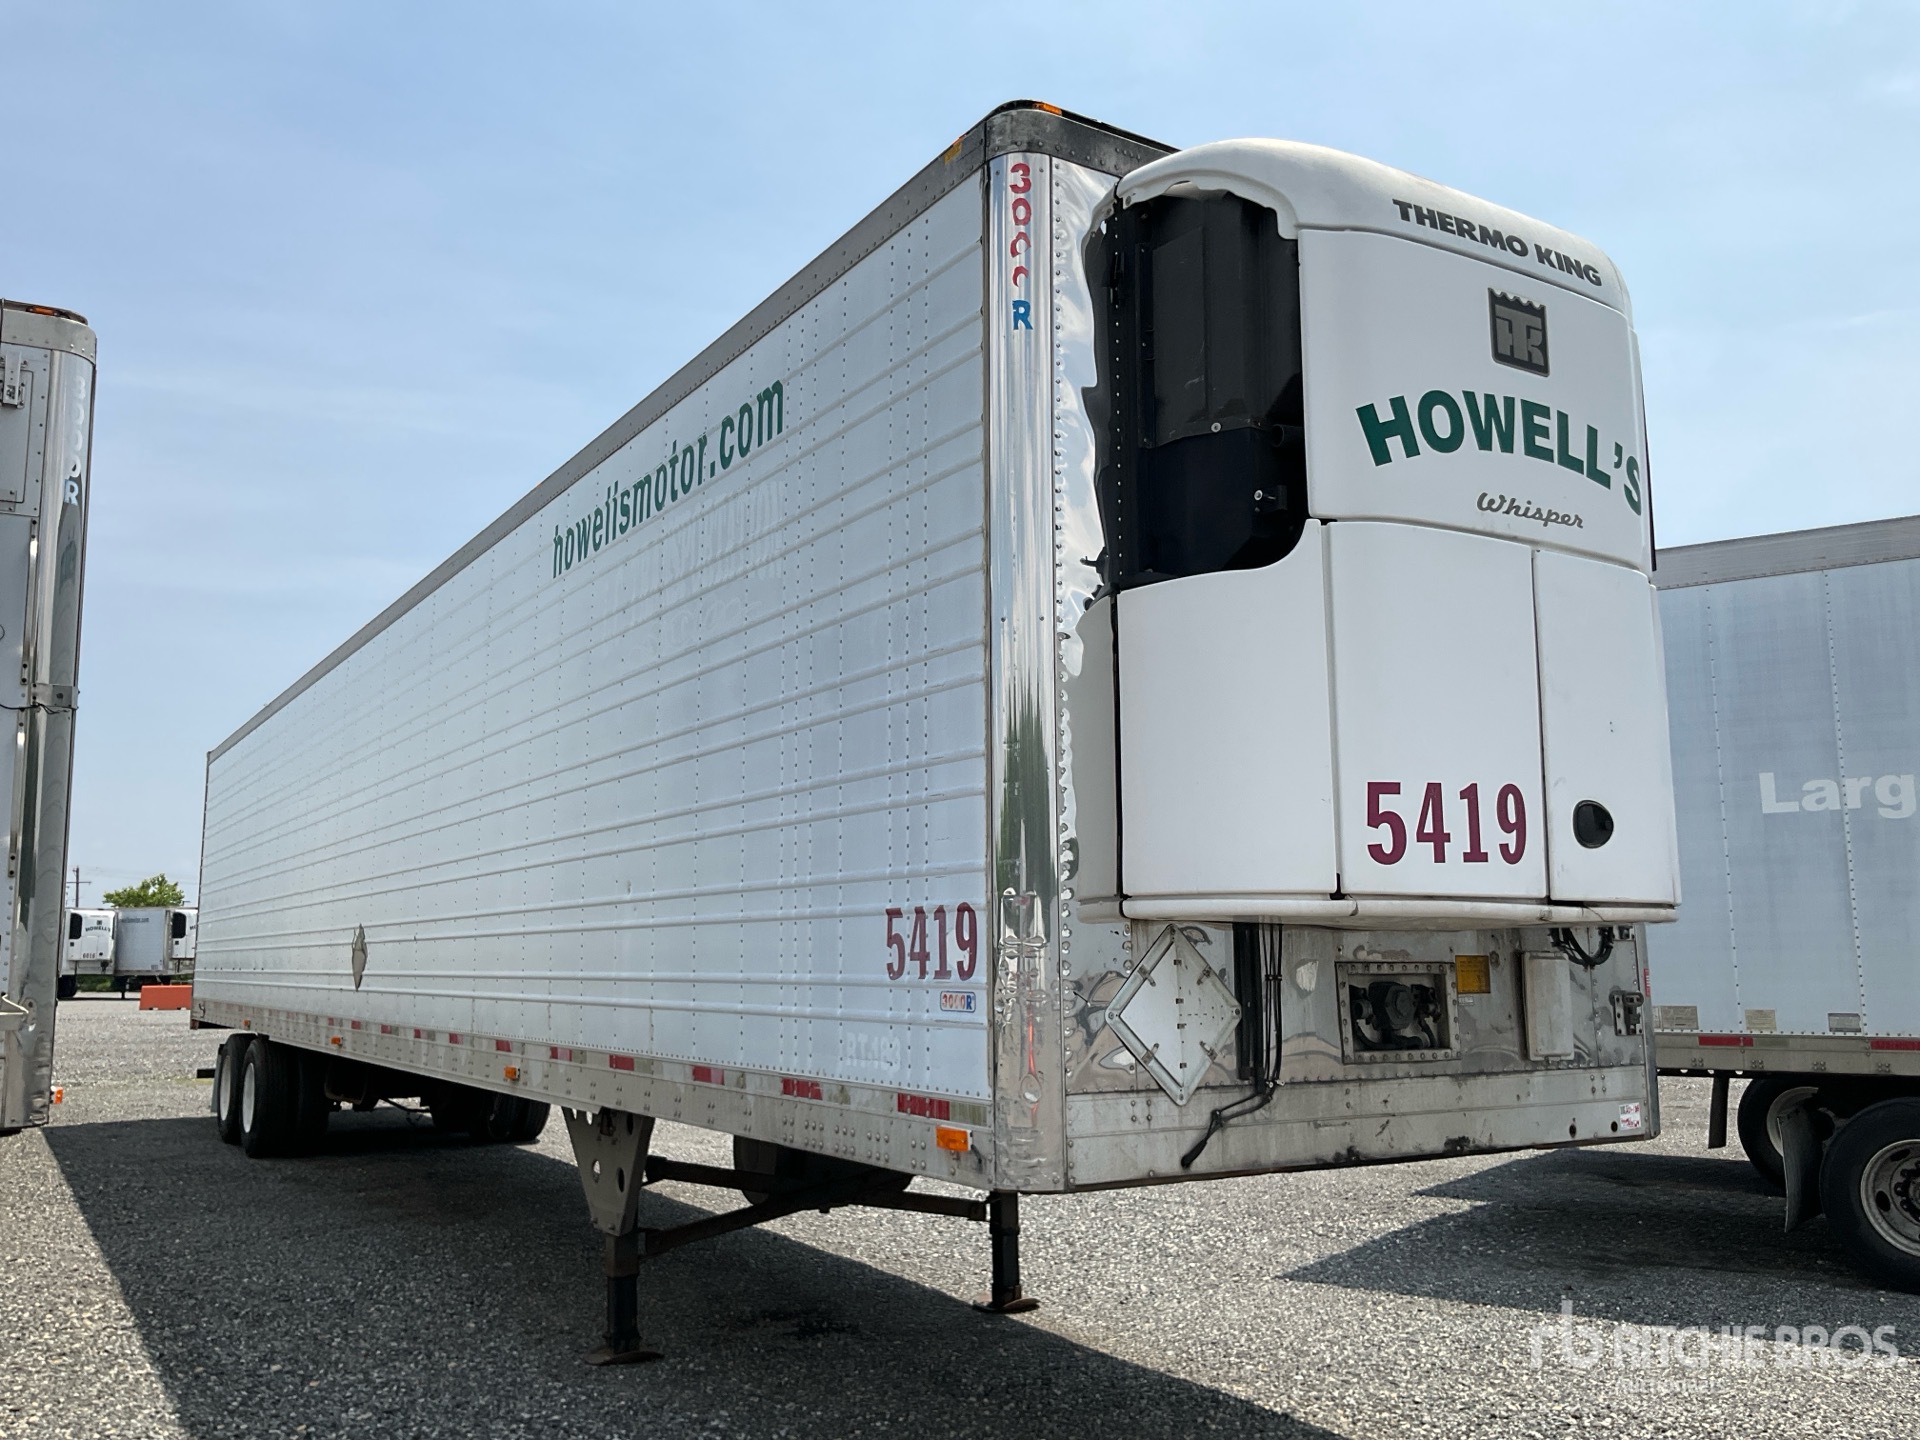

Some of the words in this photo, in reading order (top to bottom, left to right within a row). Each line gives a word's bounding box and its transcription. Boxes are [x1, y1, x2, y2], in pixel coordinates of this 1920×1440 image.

[1393, 198, 1529, 257] THERMO
[1534, 243, 1602, 286] KING
[1355, 389, 1642, 516] HOWELL'S
[1476, 492, 1584, 529] Whisper
[1366, 781, 1527, 865] 5419
[1758, 772, 1917, 819] Larg
[885, 902, 977, 980] 5419
